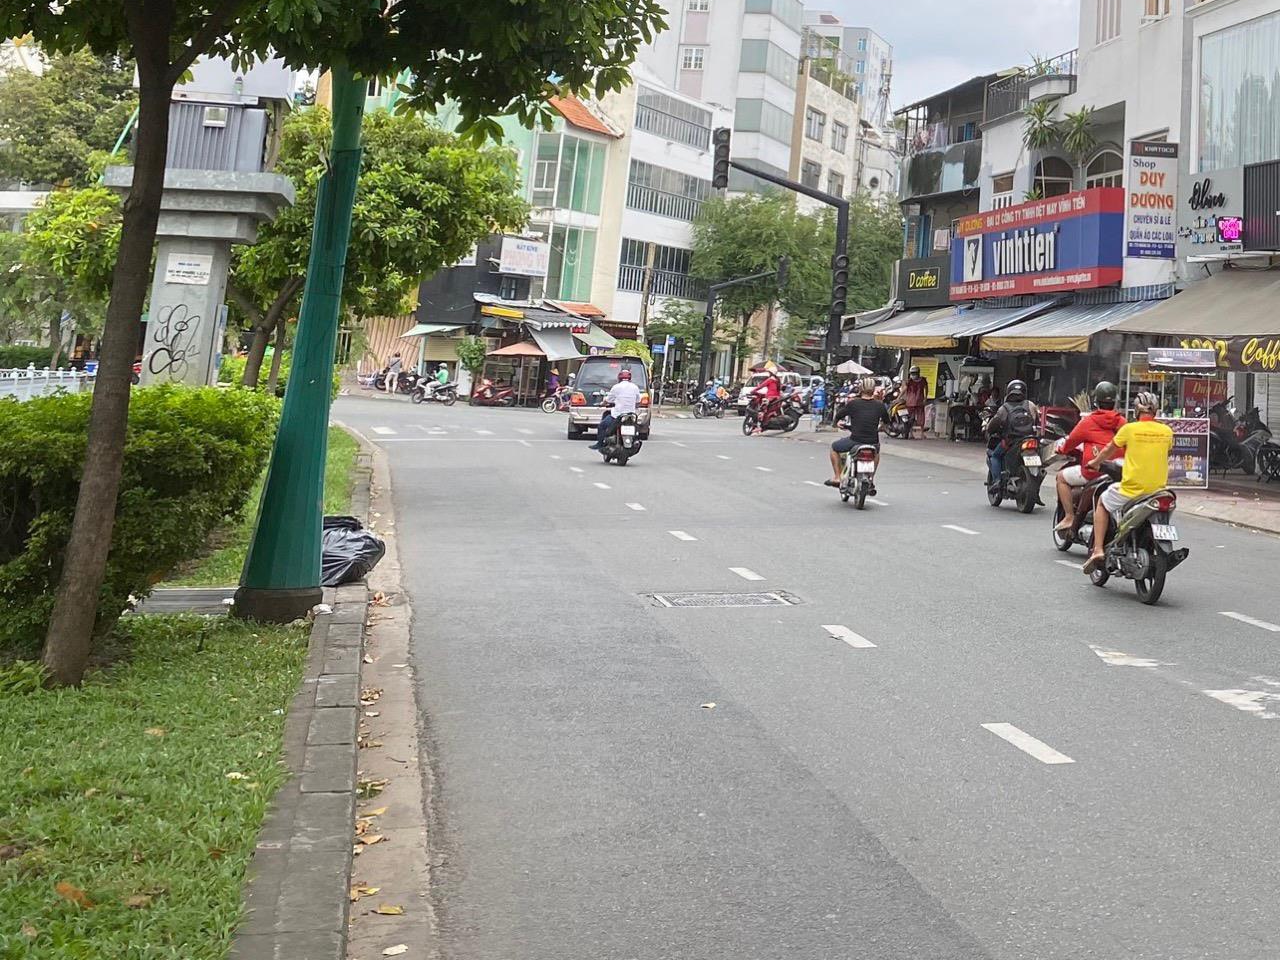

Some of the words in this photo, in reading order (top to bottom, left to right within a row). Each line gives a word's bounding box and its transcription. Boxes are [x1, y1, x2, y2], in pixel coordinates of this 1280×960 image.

[1133, 159, 1156, 170] Shop
[1140, 171, 1166, 188] DUY
[993, 227, 1055, 275] vinhtien
[909, 272, 915, 288] D
[916, 271, 936, 287] coffee
